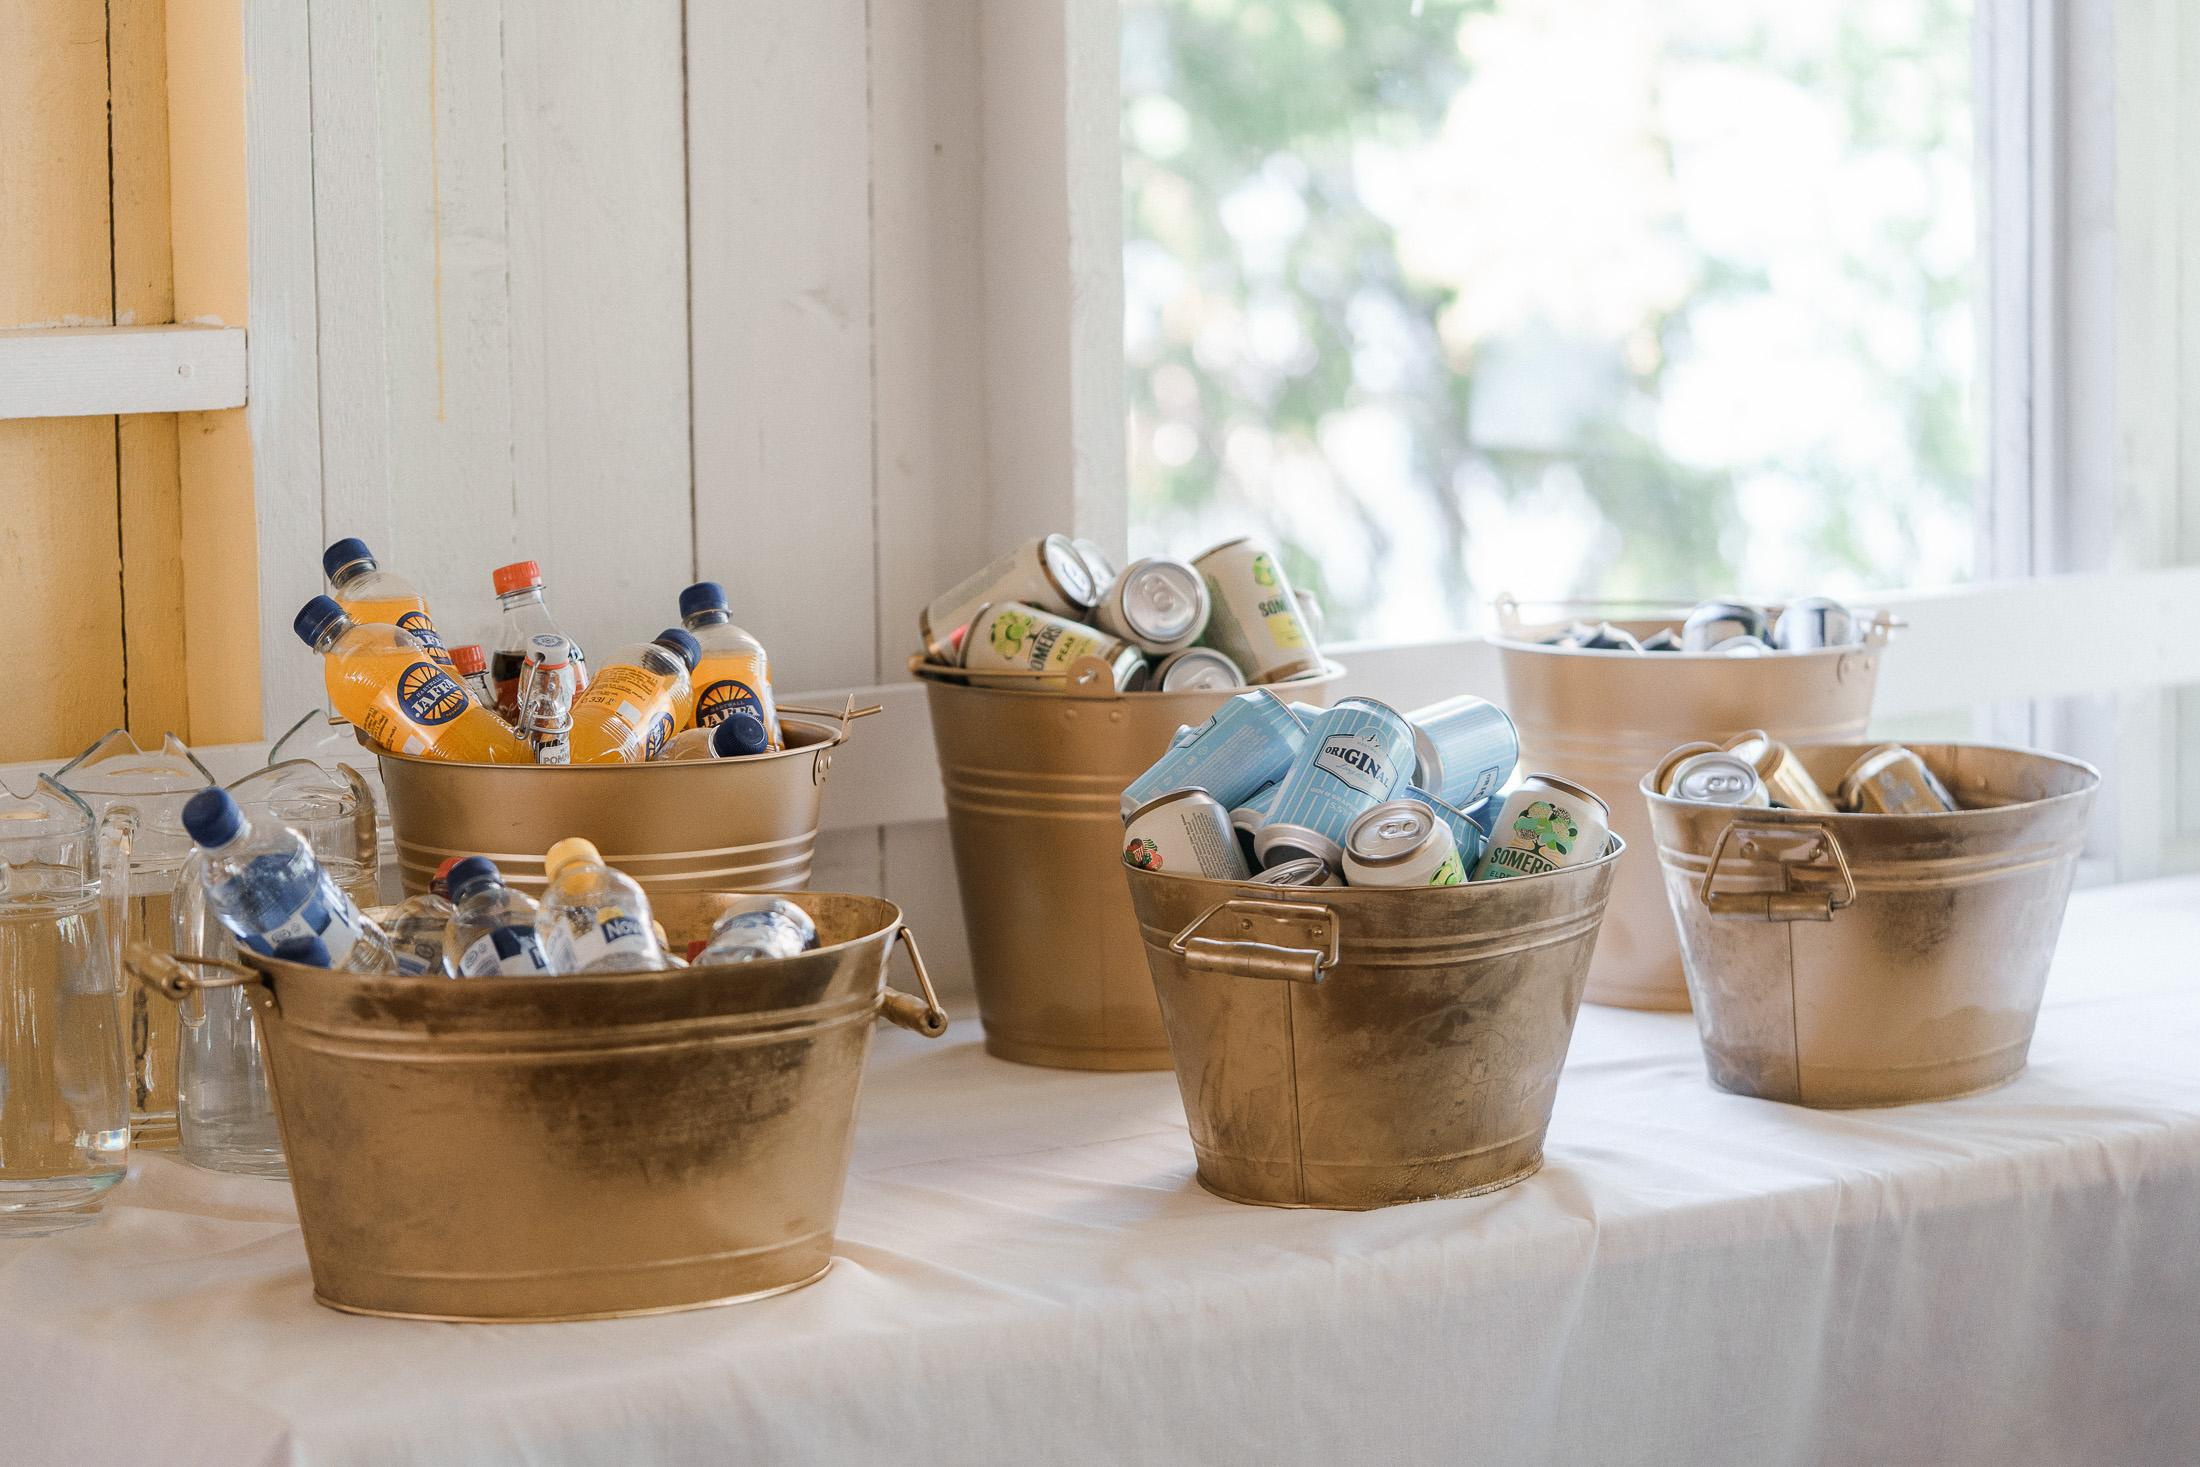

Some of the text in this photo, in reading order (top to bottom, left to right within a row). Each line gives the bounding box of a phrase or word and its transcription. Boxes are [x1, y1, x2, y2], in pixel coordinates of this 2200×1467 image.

[1258, 600, 1287, 617] SOM
[411, 679, 455, 718] JAFFA
[1325, 746, 1389, 788] ORIGINAL
[1490, 847, 1557, 874] SOMERS
